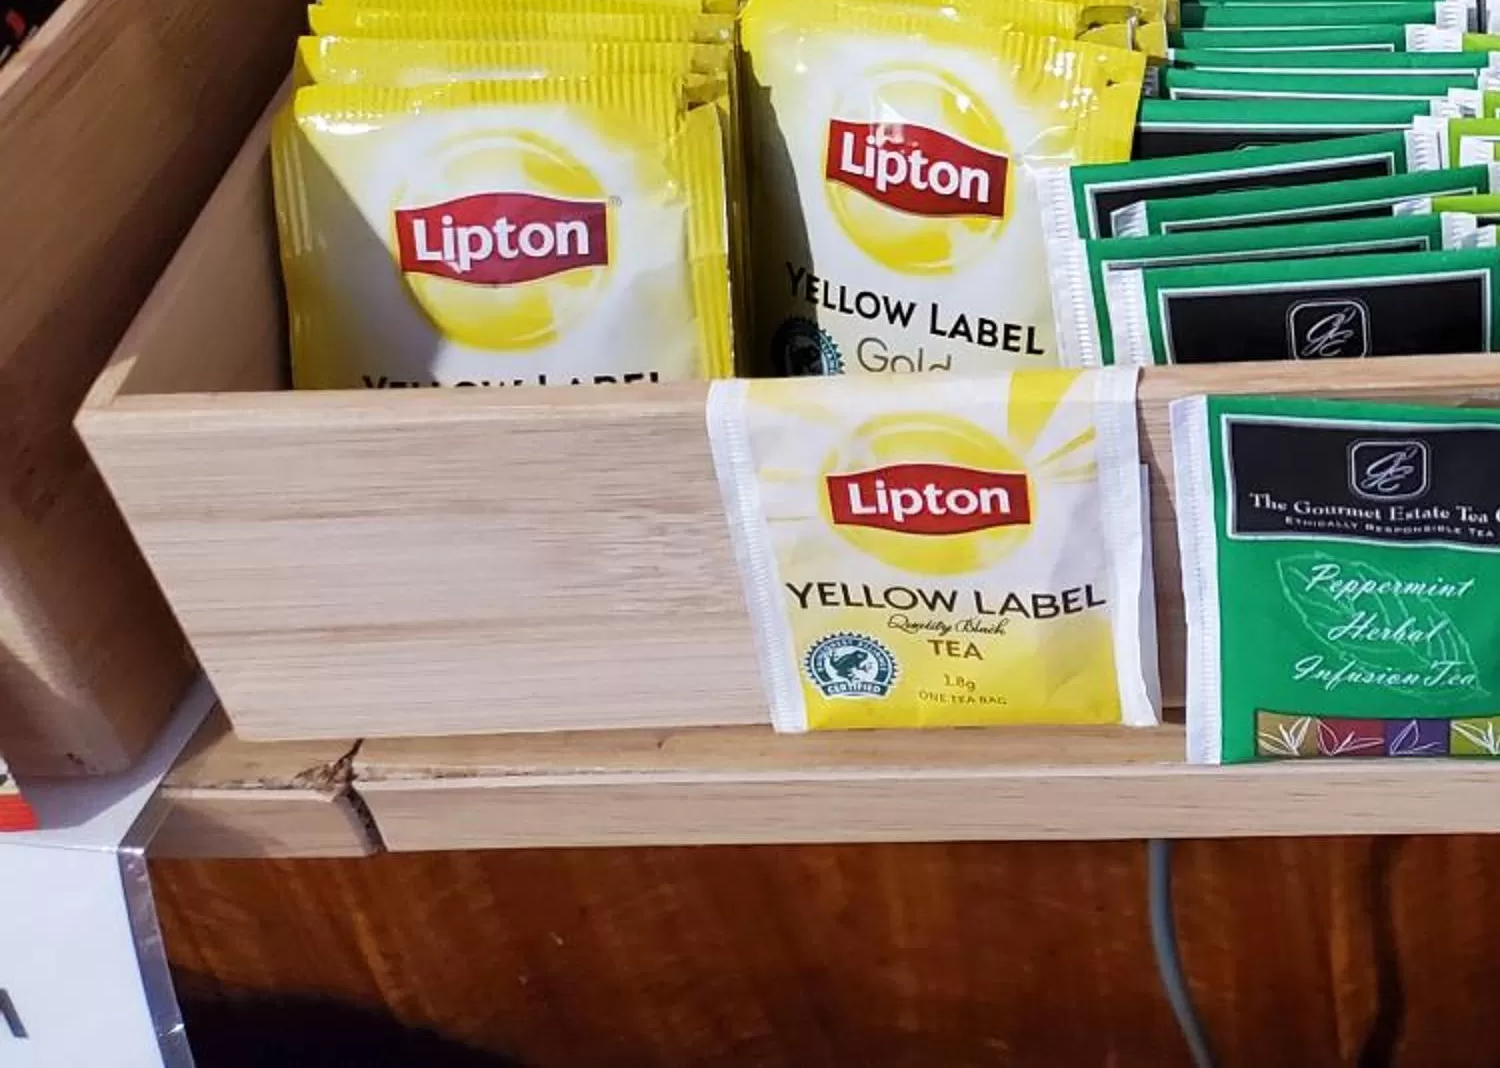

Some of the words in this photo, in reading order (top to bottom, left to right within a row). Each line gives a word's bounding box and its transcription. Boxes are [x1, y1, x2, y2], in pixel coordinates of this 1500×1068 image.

[840, 131, 990, 204] Lipton
[413, 214, 589, 273] Lipton
[786, 261, 917, 329] YELLOW
[930, 302, 1044, 355] LABEL
[847, 479, 1011, 523] Lipton
[1250, 491, 1288, 512] The
[1293, 500, 1382, 520] Gourmet
[1389, 505, 1450, 522] Estate
[1455, 505, 1489, 524] Tea
[785, 581, 959, 613] YELLOW
[975, 583, 1107, 620] LABEL
[1305, 563, 1476, 601] Peppermint
[1327, 610, 1451, 644] Herbal
[927, 638, 984, 661] TEA
[1293, 655, 1420, 691] Infusion
[1423, 659, 1477, 687] Tea
